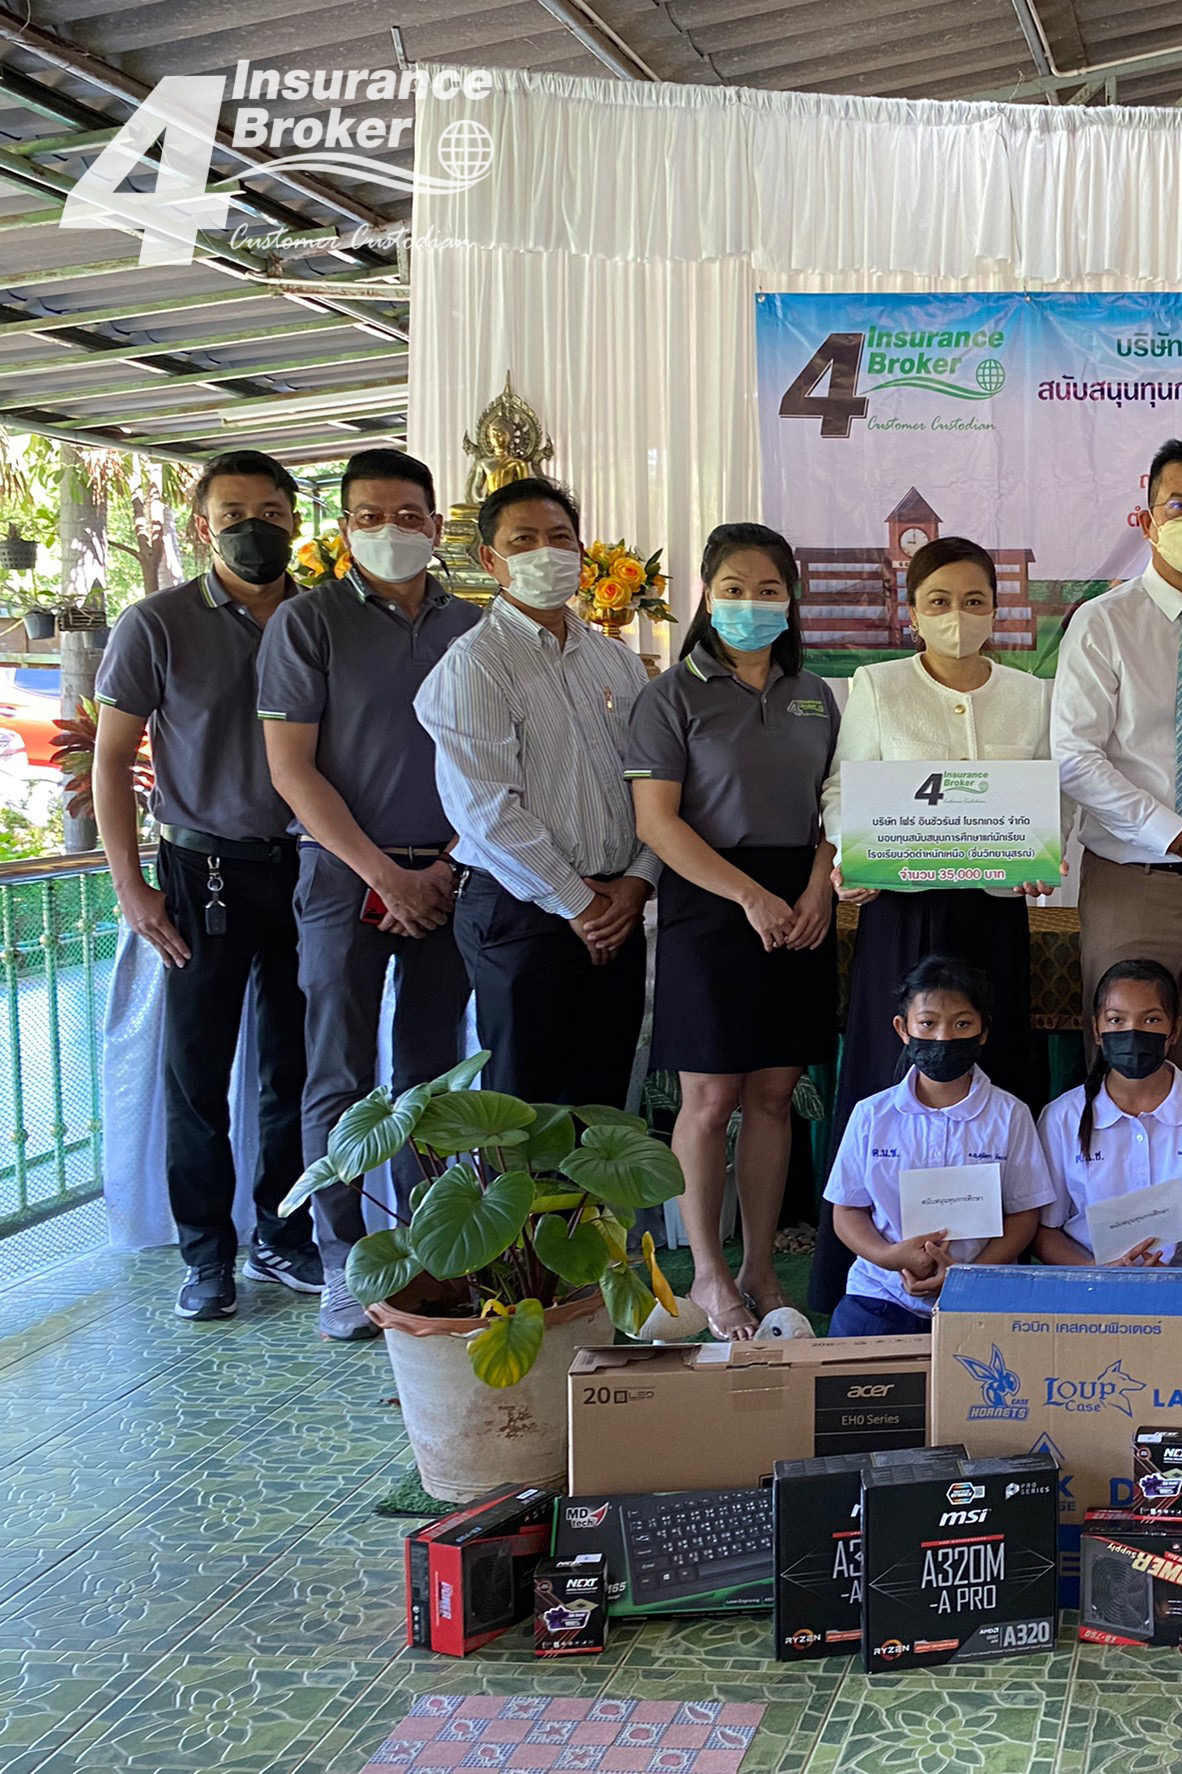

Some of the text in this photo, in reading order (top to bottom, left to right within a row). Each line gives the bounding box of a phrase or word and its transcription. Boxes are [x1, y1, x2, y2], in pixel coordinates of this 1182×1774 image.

[867, 326, 1005, 350] Insurance
[1116, 331, 1182, 358] บริษัท
[867, 352, 963, 375] Broker
[779, 333, 869, 438] 4
[867, 415, 997, 432] Customer Custodian
[943, 771, 988, 779] Insurance
[914, 773, 944, 806] 4
[943, 779, 975, 787] Broker
[872, 815, 897, 826] บริษัท
[963, 814, 1005, 826] โบรกเกอร์
[1008, 814, 1030, 825] จำกัด
[898, 868, 1005, 882] จำนวน 35,000 บาท
[1011, 1320, 1162, 1335] คิวบิก เคสคอมพิวเตอร์
[583, 1387, 610, 1404] 20
[847, 1383, 895, 1398] acer
[969, 1407, 1027, 1420] HORNETS
[1065, 1400, 1101, 1412] Case
[866, 1413, 900, 1425] Series
[566, 1508, 589, 1520] MD
[938, 1508, 989, 1526] msi
[571, 1518, 594, 1528] tech
[1107, 1543, 1137, 1560] Supply
[921, 1542, 1005, 1589] A320M
[929, 1585, 997, 1614] -A PRO
[785, 1632, 821, 1644] RYZEN
[1003, 1621, 1050, 1647] A320
[873, 1644, 910, 1656] RYZEN
